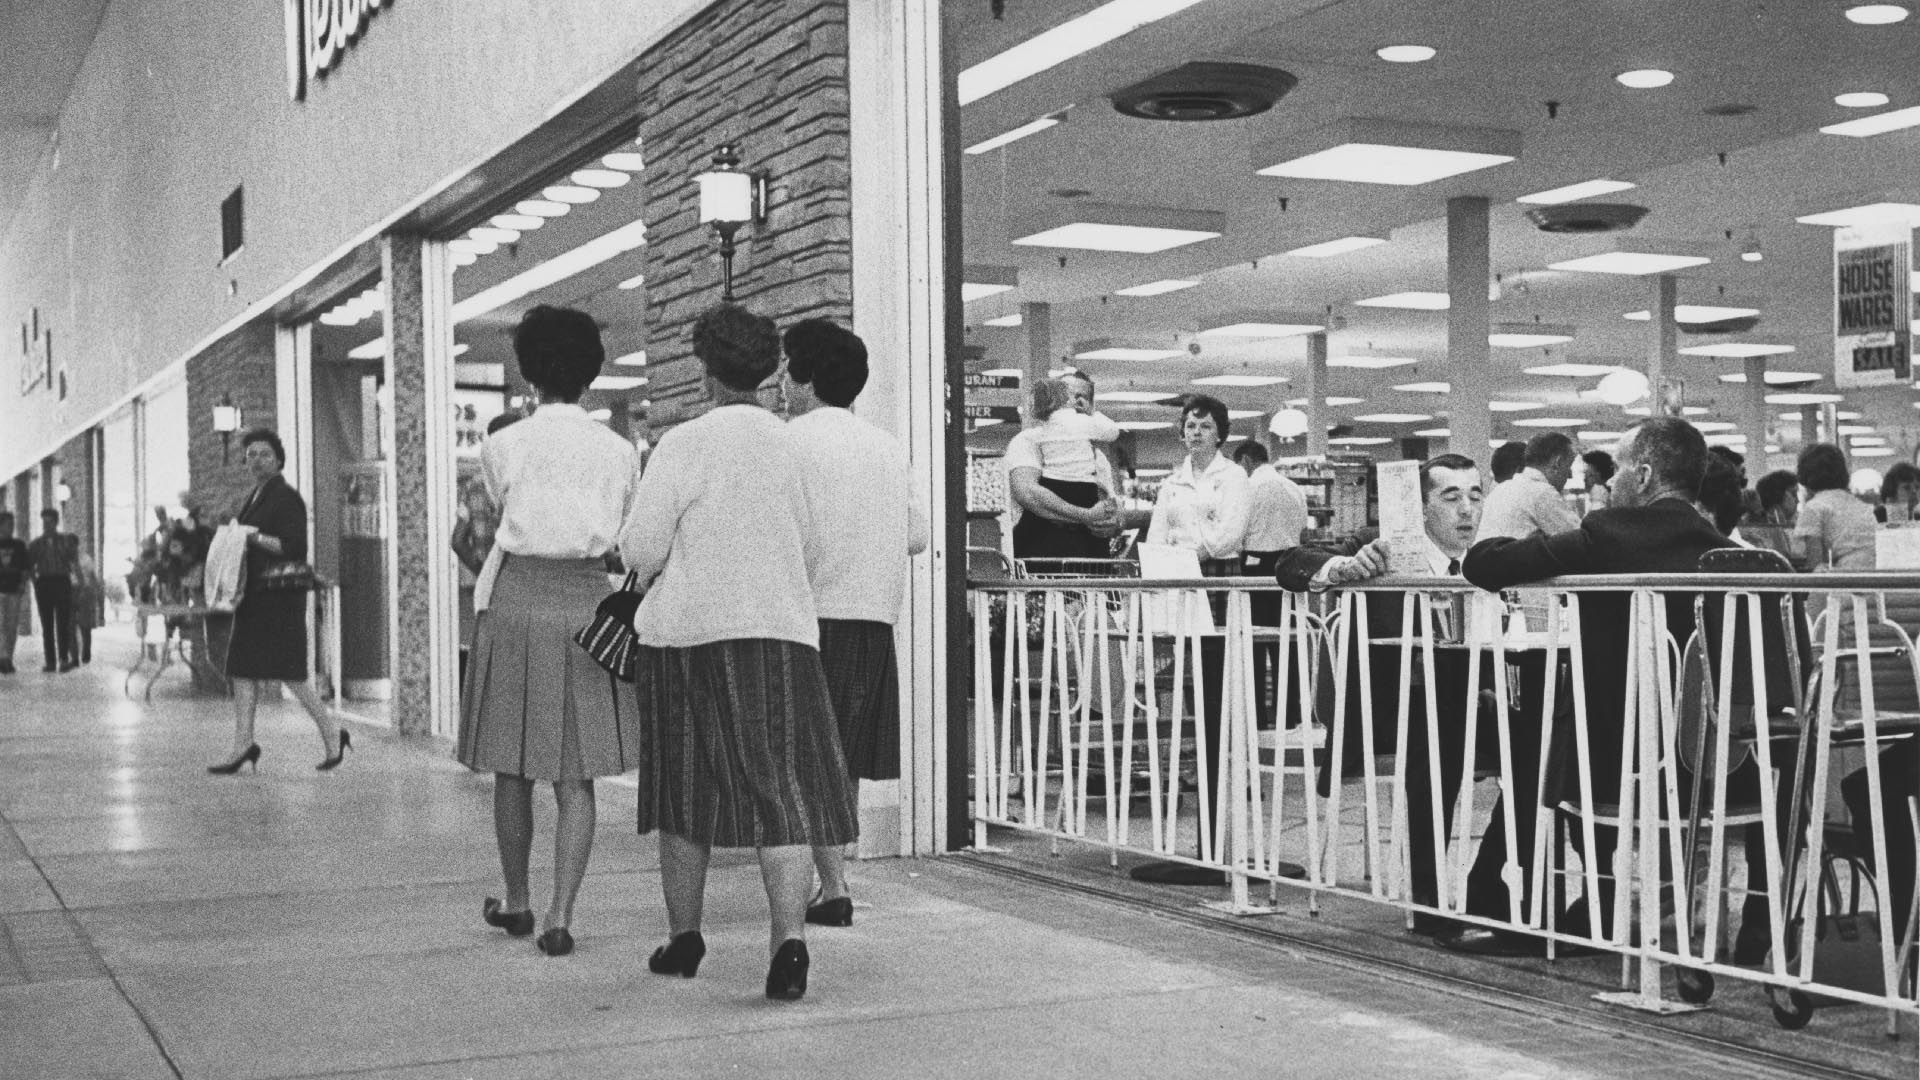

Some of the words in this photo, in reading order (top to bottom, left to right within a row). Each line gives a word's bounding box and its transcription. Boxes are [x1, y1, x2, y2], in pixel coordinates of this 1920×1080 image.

[1840, 261, 1893, 294] HOUSE
[1840, 295, 1893, 328] WARES
[1856, 346, 1903, 369] SALE
